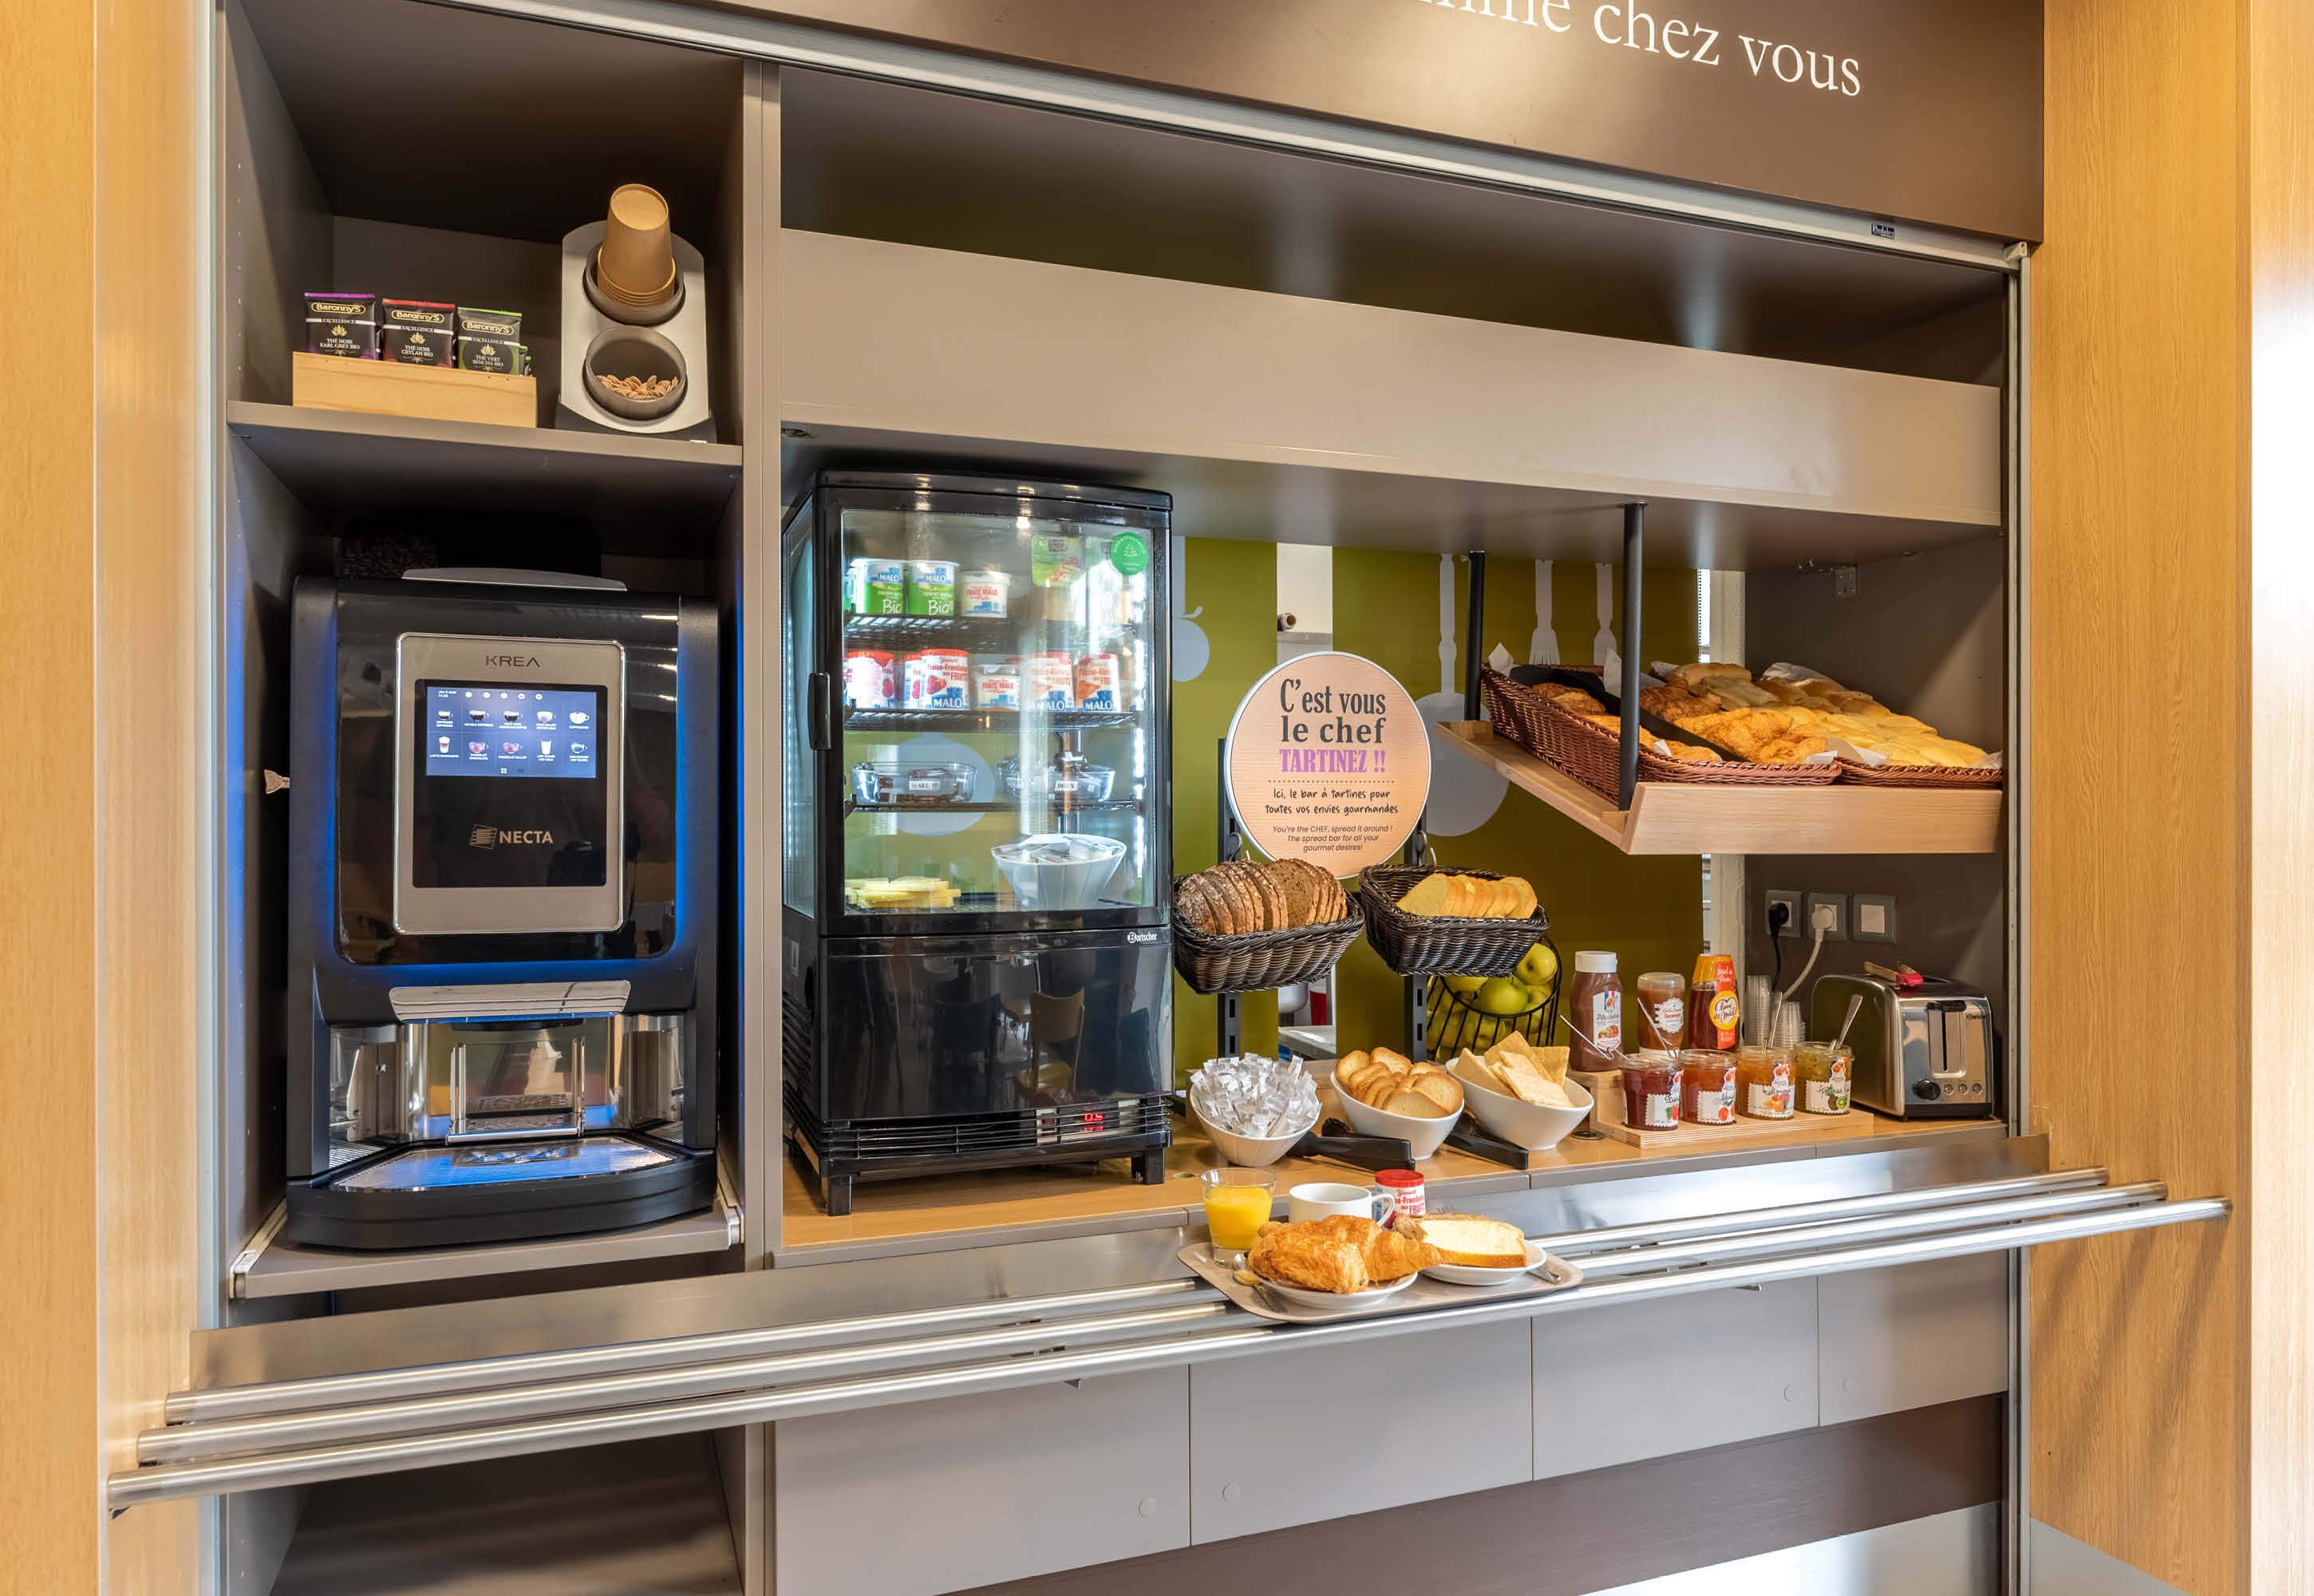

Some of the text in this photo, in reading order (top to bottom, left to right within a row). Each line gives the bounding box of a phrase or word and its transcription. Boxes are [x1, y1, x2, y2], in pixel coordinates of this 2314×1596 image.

[1593, 0, 1720, 65] chez
[1738, 34, 1861, 97] vous
[879, 574, 899, 583] MALO
[925, 574, 947, 583] MALO
[883, 598, 902, 614] Bio
[928, 599, 950, 615] Bio
[485, 655, 540, 667] KREA
[1280, 678, 1386, 714] C'est vous
[933, 697, 962, 709] MALO
[1036, 701, 1065, 712] MALO
[1084, 701, 1112, 711] MALO
[1281, 715, 1387, 743] le chef
[1279, 749, 1386, 772] TARTINEZ !!
[1289, 788, 1297, 798] le
[1301, 788, 1317, 799] bar
[1321, 787, 1328, 798] à
[1331, 788, 1366, 799] tartines
[1370, 789, 1391, 801] pour
[1265, 804, 1399, 816] toutes vos envies gourmandes
[499, 830, 554, 843] NECTA
[1331, 825, 1356, 836] spread
[1301, 835, 1327, 843] spread
[1127, 932, 1157, 943] Bartscher
